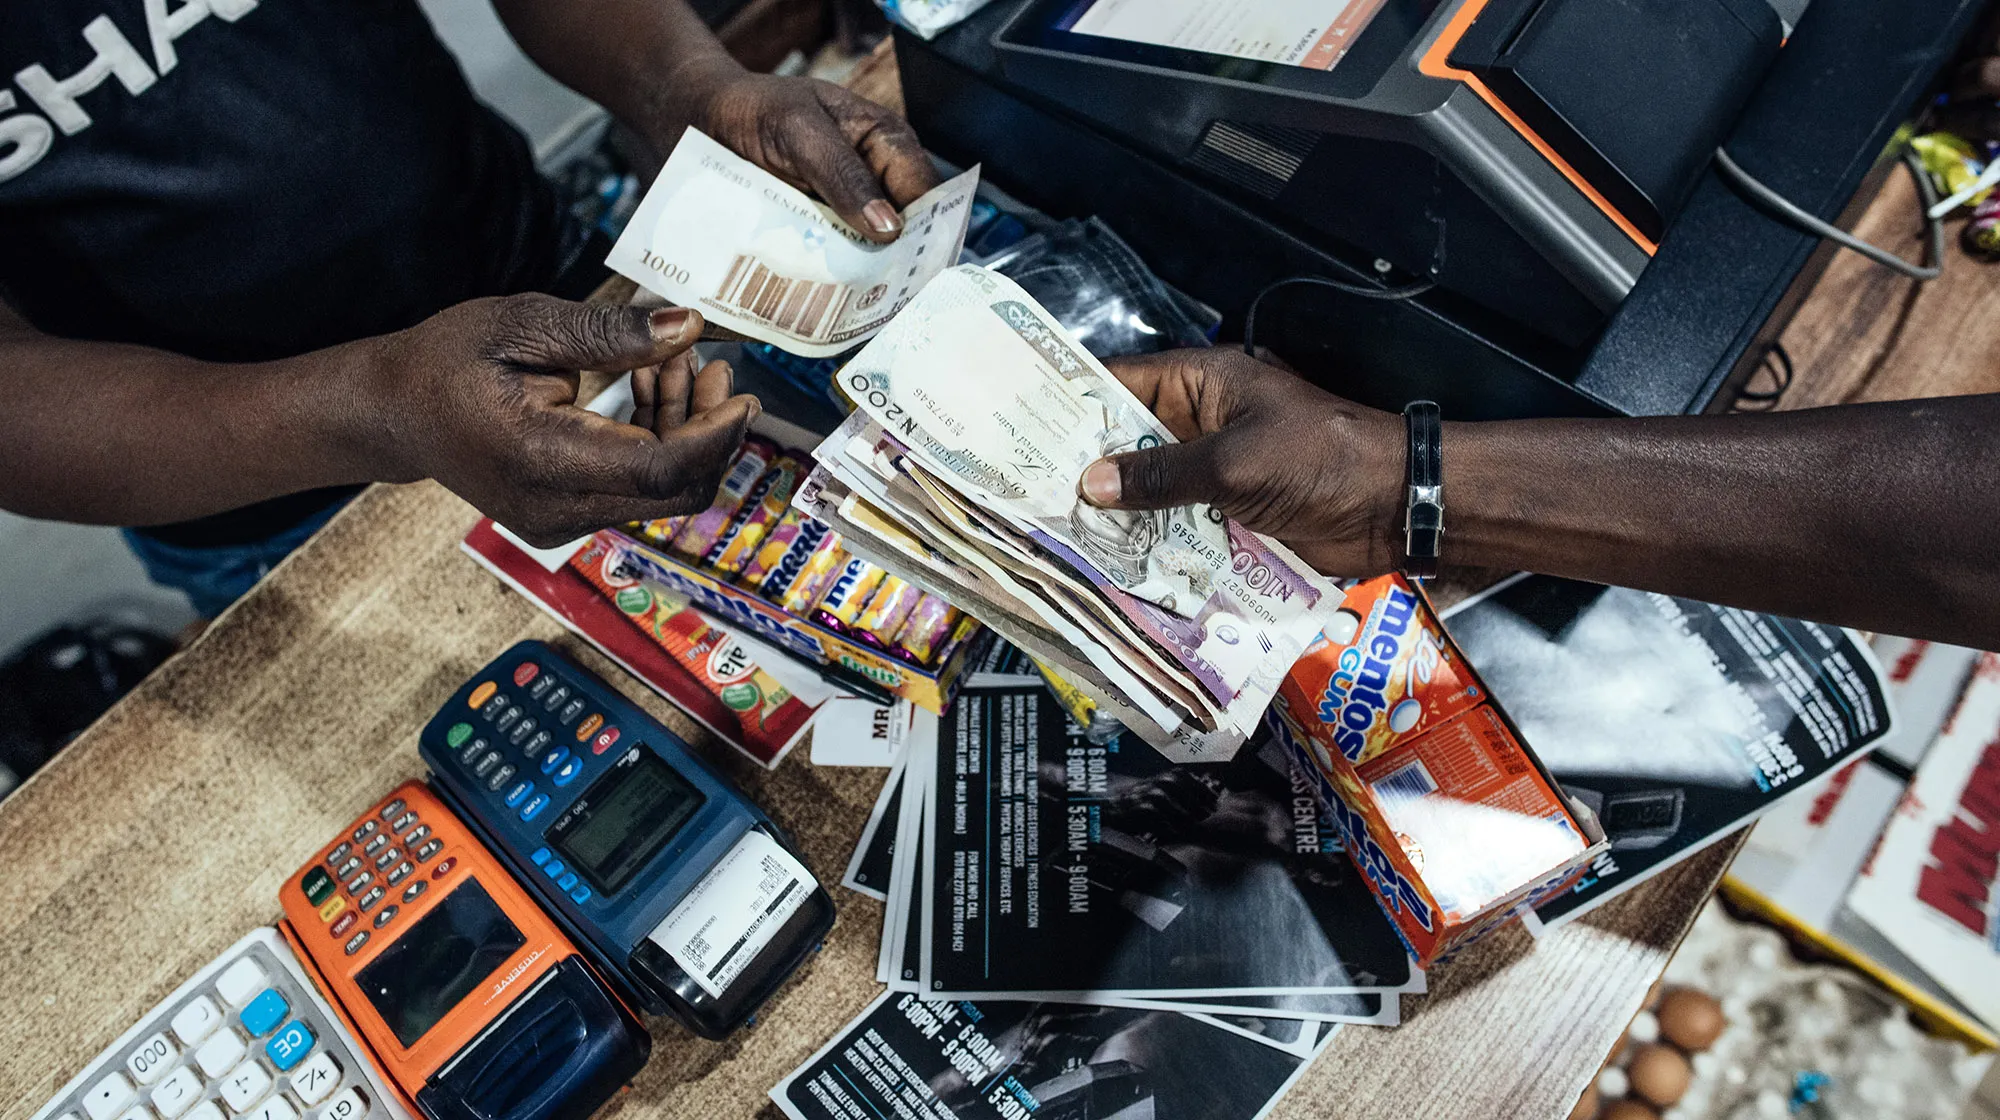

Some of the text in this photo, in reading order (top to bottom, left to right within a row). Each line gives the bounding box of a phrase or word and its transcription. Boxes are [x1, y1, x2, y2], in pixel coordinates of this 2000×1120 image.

[0, 0, 258, 182] SHA
[637, 247, 692, 287] 1000
[911, 386, 955, 427] 977546
[990, 409, 1059, 473] Hundred Naira
[920, 433, 1007, 504] Central Bank
[959, 440, 1009, 488] Nigeria
[758, 516, 831, 601] mento
[1170, 518, 1216, 564] 977546
[1209, 558, 1222, 571] AC
[1221, 572, 1277, 628] HU090027
[716, 646, 751, 683] ala
[842, 653, 899, 688] fruit
[1317, 645, 1362, 725] GUM
[1333, 582, 1419, 764] mentos
[1013, 751, 1024, 770] TABLE
[1066, 748, 1086, 791] 9:00PM
[1086, 747, 1106, 792] 6:00AM
[521, 795, 541, 816] FUNC
[1026, 779, 1037, 803] WEIGHT
[1000, 803, 1011, 834] PHYSICAL
[1013, 801, 1024, 832] AEROBICS
[1026, 804, 1037, 820] LOSS
[1088, 805, 1099, 844] SATURDAY
[1292, 796, 1318, 854] CENTRE
[1000, 835, 1011, 865] THERAPY
[1013, 832, 1024, 867] EXERCISES
[1026, 821, 1037, 855] EXERCISES
[1026, 862, 1037, 884] FITNESS
[1066, 805, 1088, 913] 5:30AM 9:00AM
[305, 875, 328, 897] ENTER
[966, 851, 978, 919] FOR MORE CALL
[1026, 885, 1037, 928] EDUCATION
[344, 931, 366, 951] MENU
[128, 1037, 171, 1075] 000
[269, 1025, 307, 1060] CE
[896, 995, 987, 1084] 6:00PM 9:00PM
[957, 1024, 1004, 1069] 6:00AM
[843, 1048, 870, 1074] HEALTHY
[865, 1072, 895, 1101] LIFESTYLE
[854, 1038, 878, 1061] BOXING
[872, 1058, 900, 1085] CLASSES
[901, 1087, 921, 1108] TABLE
[865, 1029, 883, 1046] BODY
[879, 1044, 906, 1070] BUILDING
[901, 1067, 933, 1099] EXERCISES
[804, 1078, 843, 1115] PENTHOUSE
[815, 1070, 866, 1120] TOMAVILLE EVENT
[1001, 1074, 1042, 1112] SATURDAY
